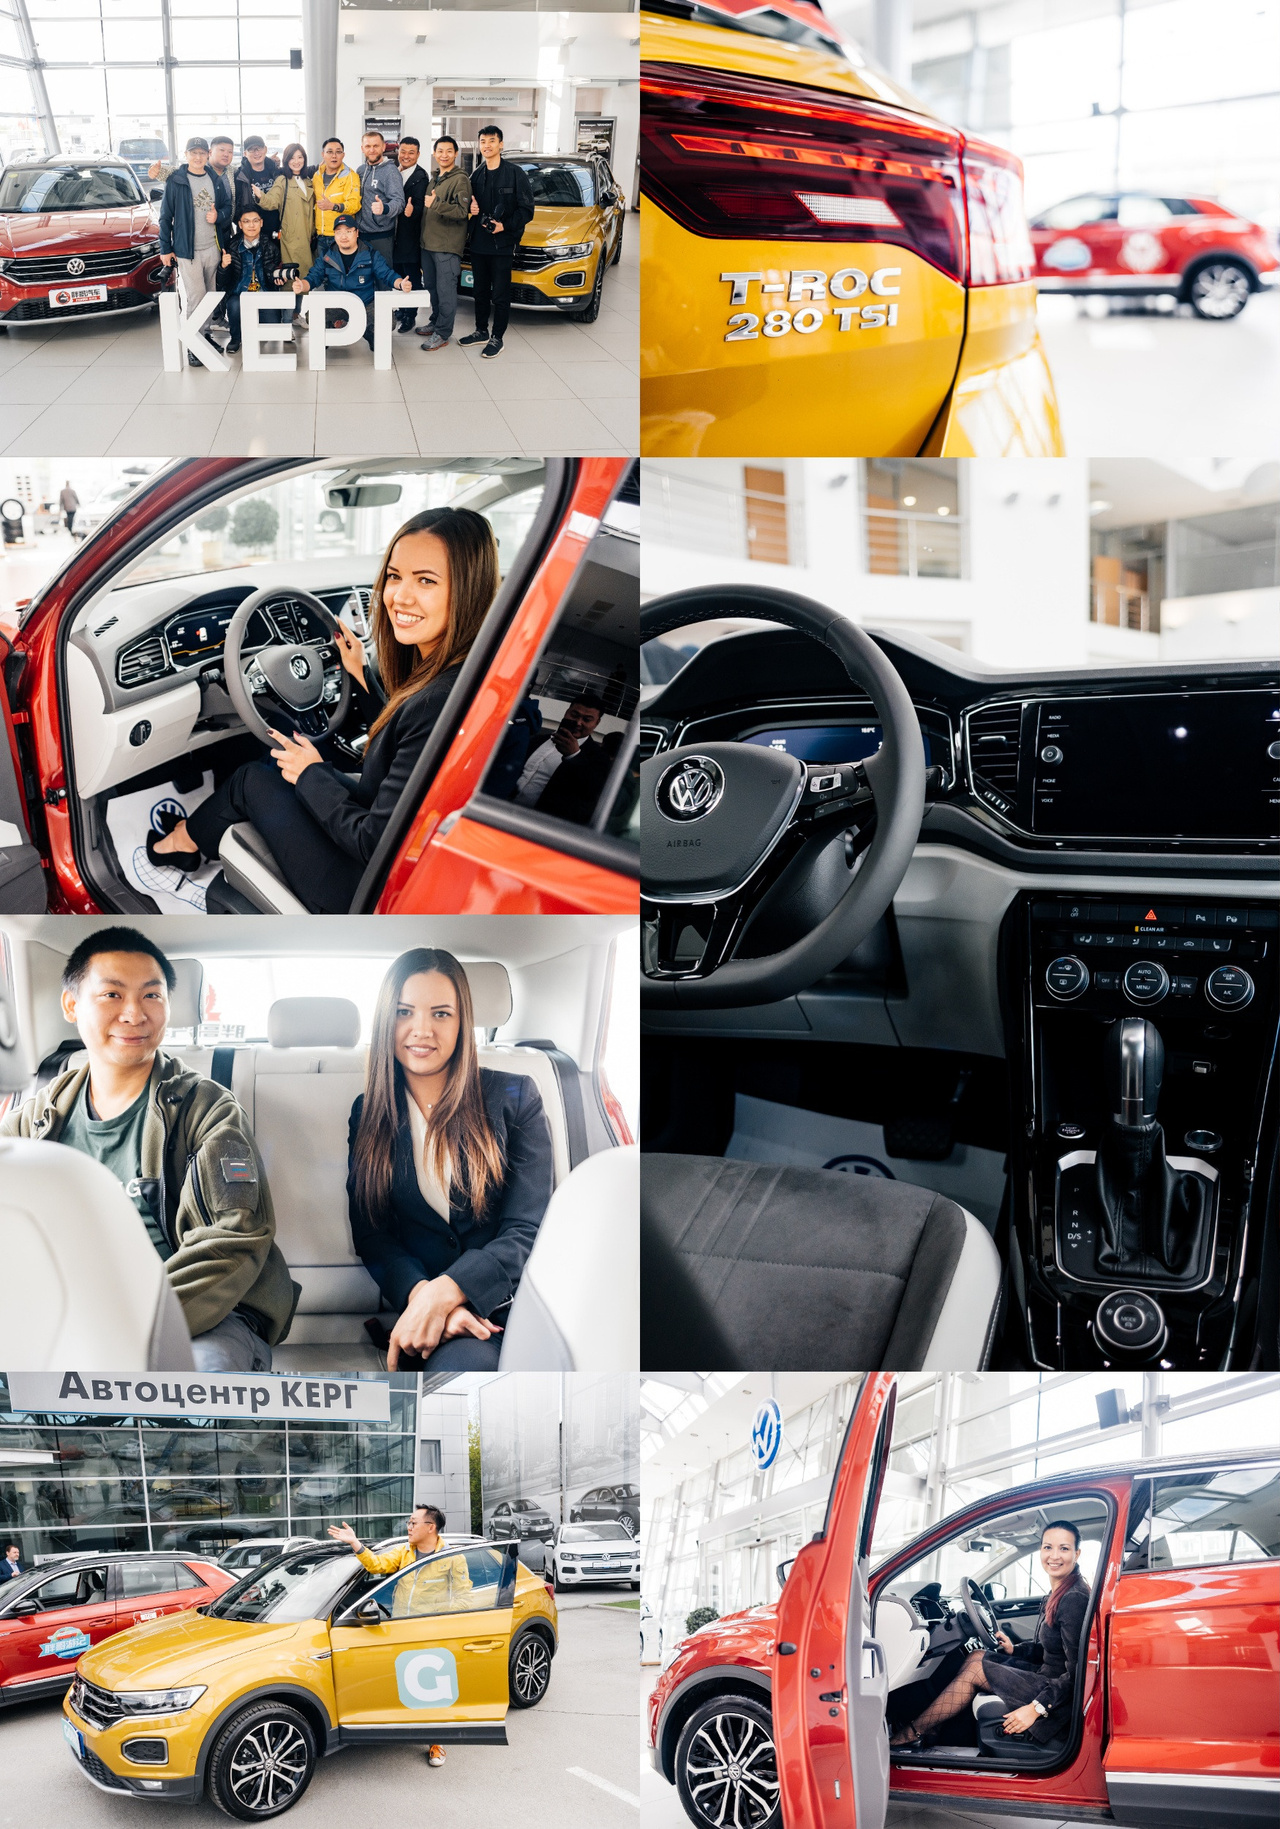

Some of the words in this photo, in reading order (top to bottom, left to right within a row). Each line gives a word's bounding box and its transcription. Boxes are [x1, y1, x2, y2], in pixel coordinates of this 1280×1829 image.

[720, 267, 902, 305] T-ROC
[159, 290, 431, 372] КЕРГ
[724, 307, 823, 342] 280
[832, 303, 899, 332] TSI
[666, 839, 702, 848] AIRBAG
[58, 1372, 270, 1413] Автоцентр
[281, 1381, 358, 1409] КЕРГ
[404, 1653, 454, 1702] G
